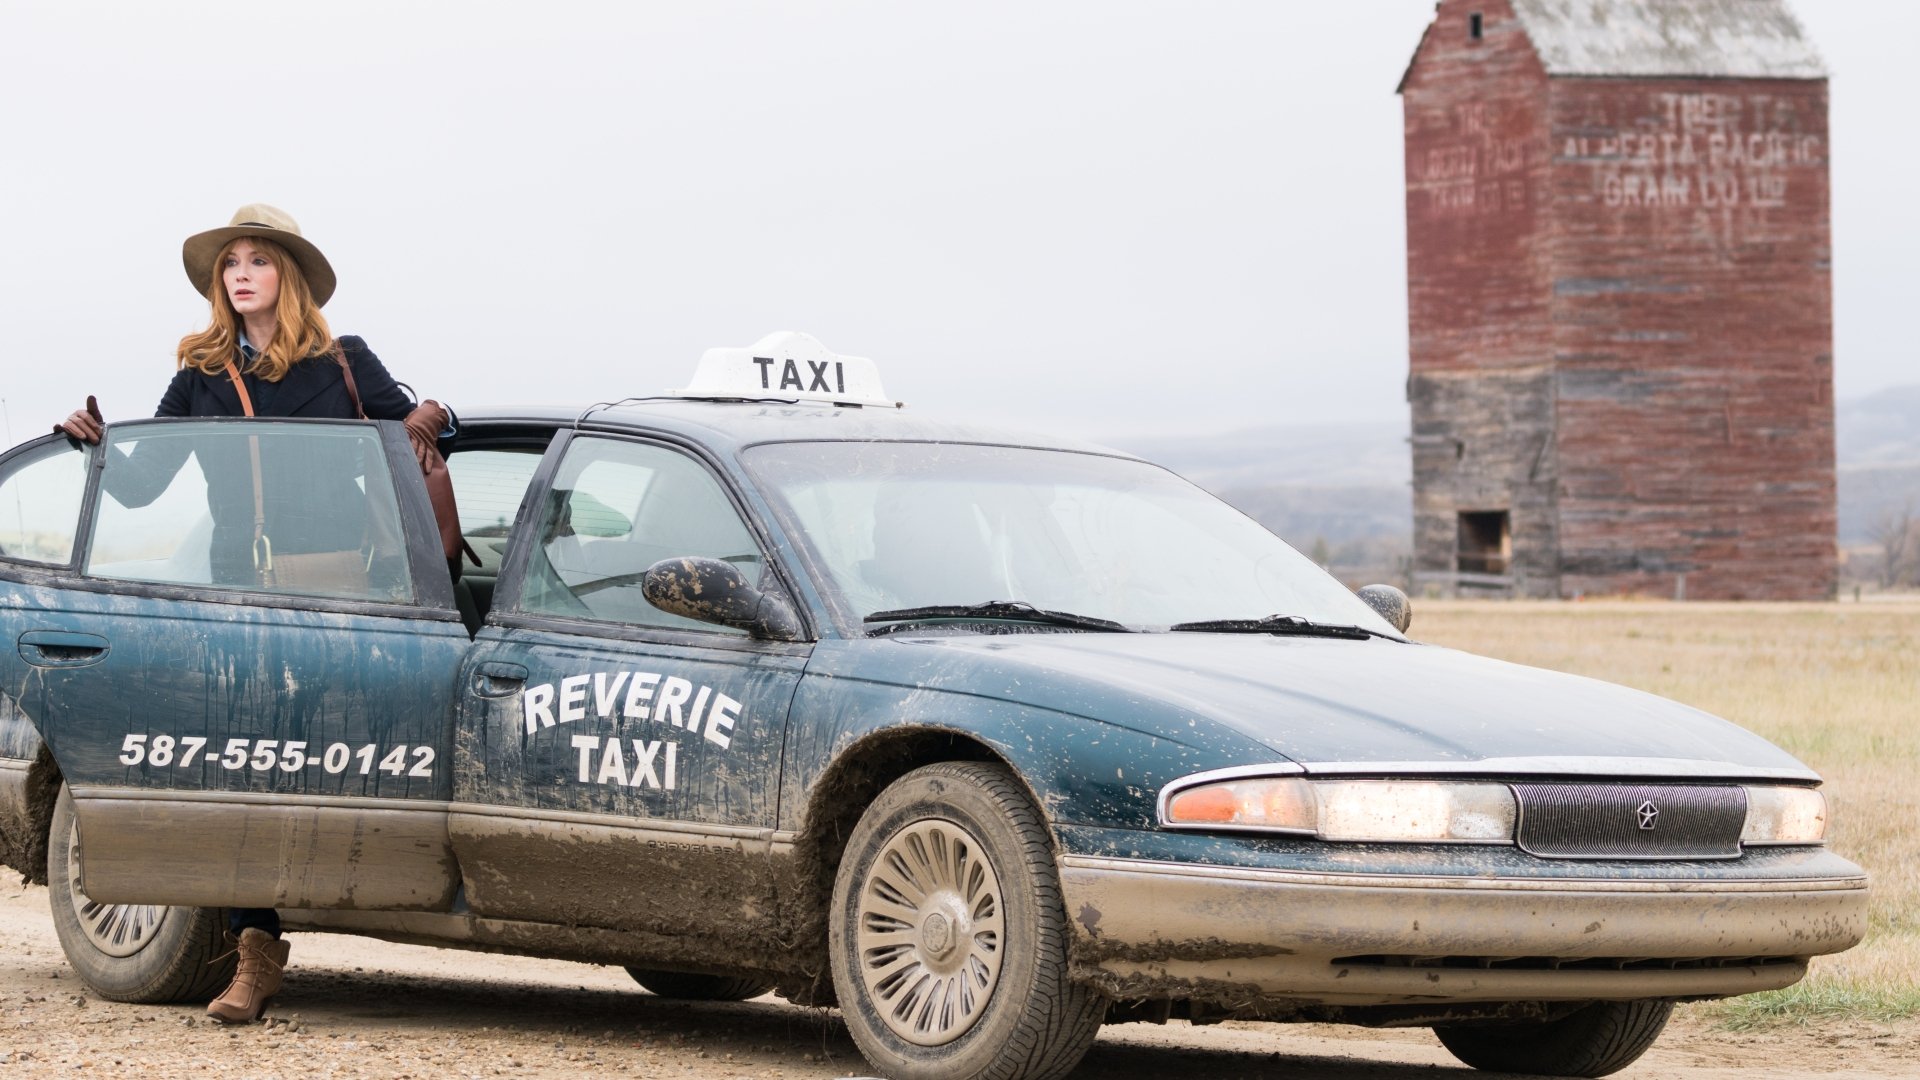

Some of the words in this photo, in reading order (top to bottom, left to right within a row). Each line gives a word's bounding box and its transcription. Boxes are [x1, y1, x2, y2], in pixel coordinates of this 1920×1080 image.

[1603, 173, 1690, 208] GRAIN
[1701, 173, 1740, 208] CO
[752, 356, 845, 393] TAXI
[524, 671, 743, 749] REVERIE
[119, 734, 435, 778] 587-555-0142
[571, 734, 677, 790] TAXI
